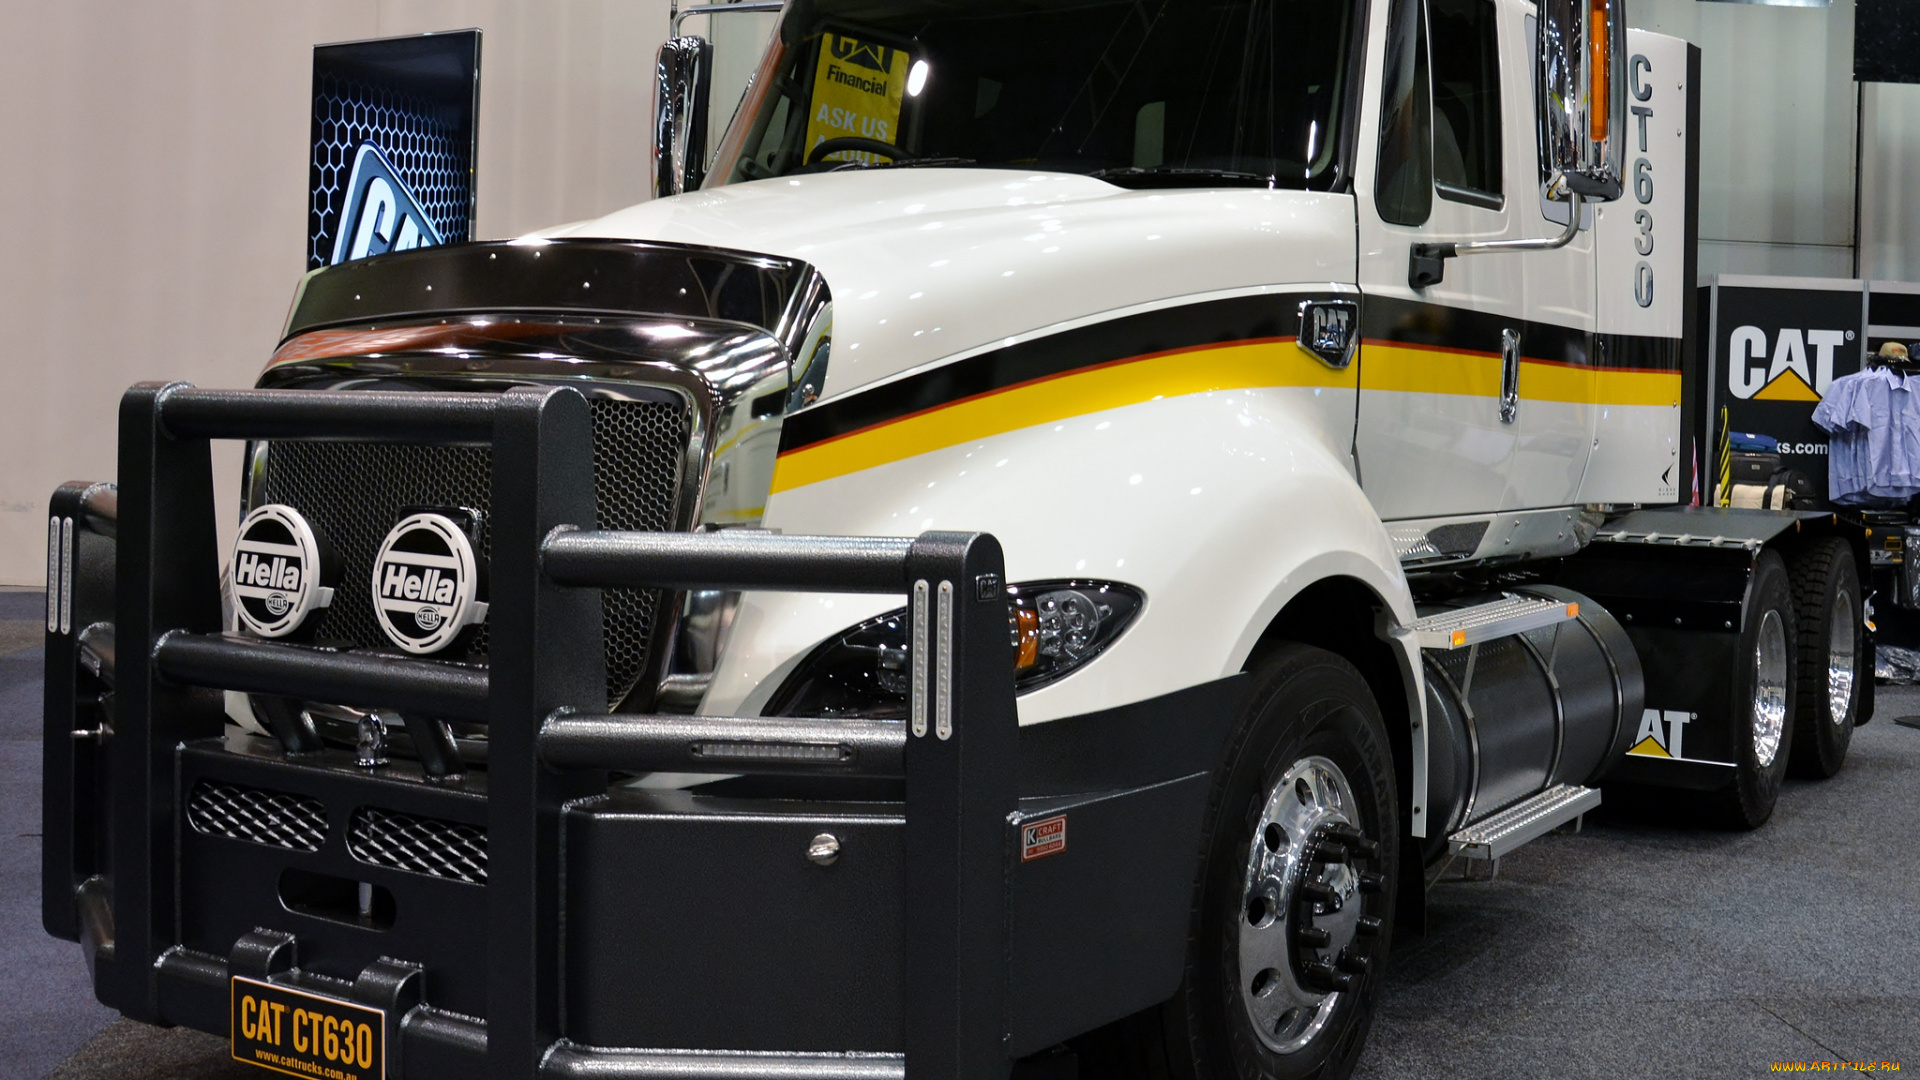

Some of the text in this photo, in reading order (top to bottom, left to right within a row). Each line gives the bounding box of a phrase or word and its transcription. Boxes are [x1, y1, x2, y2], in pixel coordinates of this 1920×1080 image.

[826, 64, 887, 96] Financial
[816, 103, 888, 140] ASK US
[1629, 54, 1653, 307] CT630
[1313, 306, 1348, 351] CAT
[237, 553, 300, 590] Hella
[382, 564, 455, 604] Hella
[418, 612, 440, 622] HELLA
[1629, 708, 1690, 759] AT
[1027, 823, 1061, 845] K CRAFT
[242, 995, 372, 1069] CAT CT630
